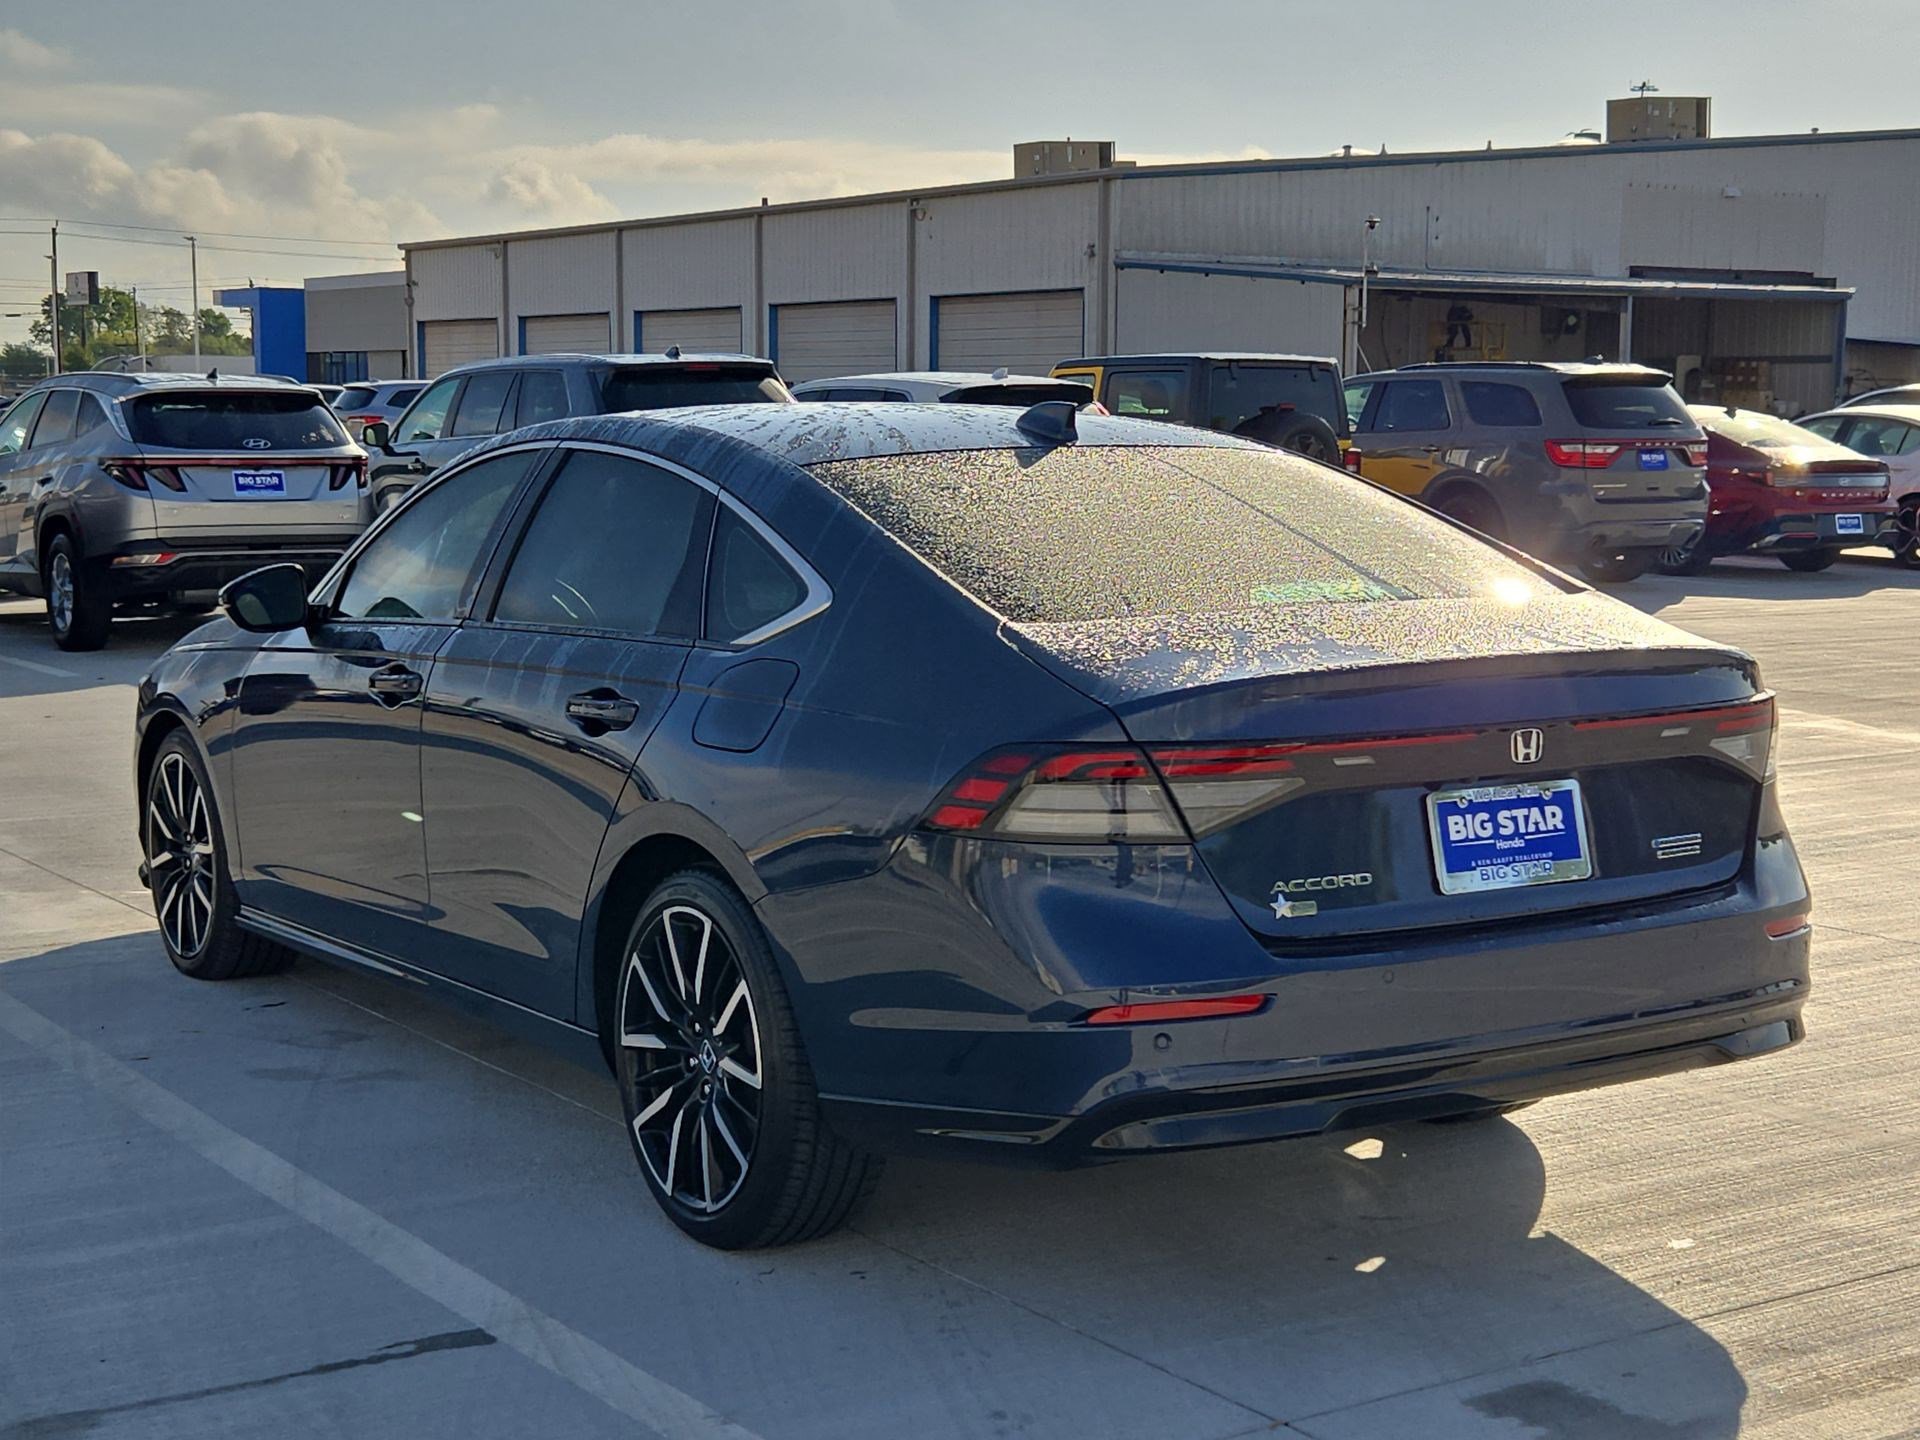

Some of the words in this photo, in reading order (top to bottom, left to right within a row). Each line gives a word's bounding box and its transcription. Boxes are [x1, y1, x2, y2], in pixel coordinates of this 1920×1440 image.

[238, 476, 255, 485] BIG
[255, 476, 279, 485] STAR
[1447, 813, 1494, 841] BIG
[1497, 805, 1566, 836] STAR
[1496, 837, 1525, 850] Honda
[1480, 866, 1507, 881] BIG
[1511, 861, 1552, 878] STAR
[1270, 872, 1373, 894] ACCORD
